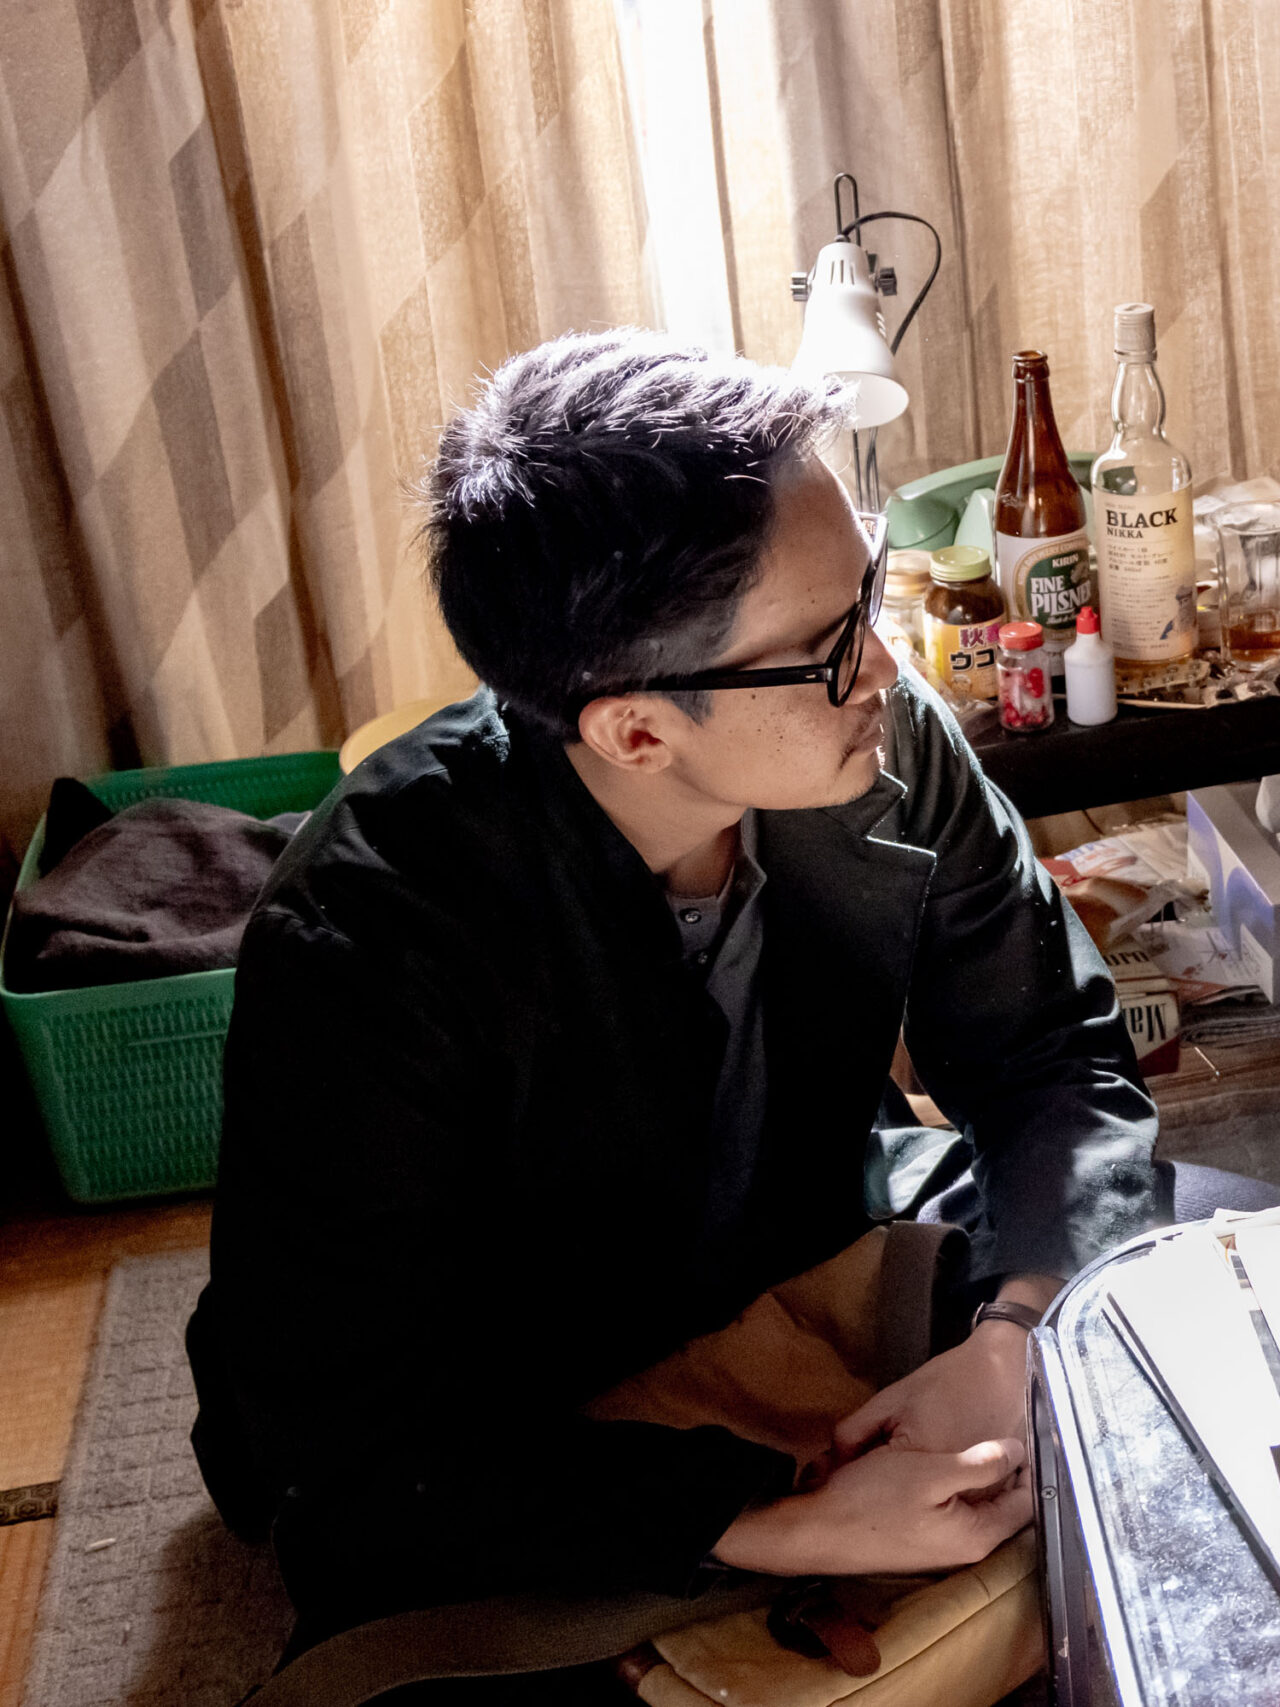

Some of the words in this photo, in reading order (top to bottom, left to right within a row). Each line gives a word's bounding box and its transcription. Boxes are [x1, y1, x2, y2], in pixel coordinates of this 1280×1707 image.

[1106, 507, 1178, 528] BLACK
[1106, 527, 1143, 539] NIKKA
[1052, 552, 1079, 569] KIRIN
[1030, 575, 1065, 593] FINE
